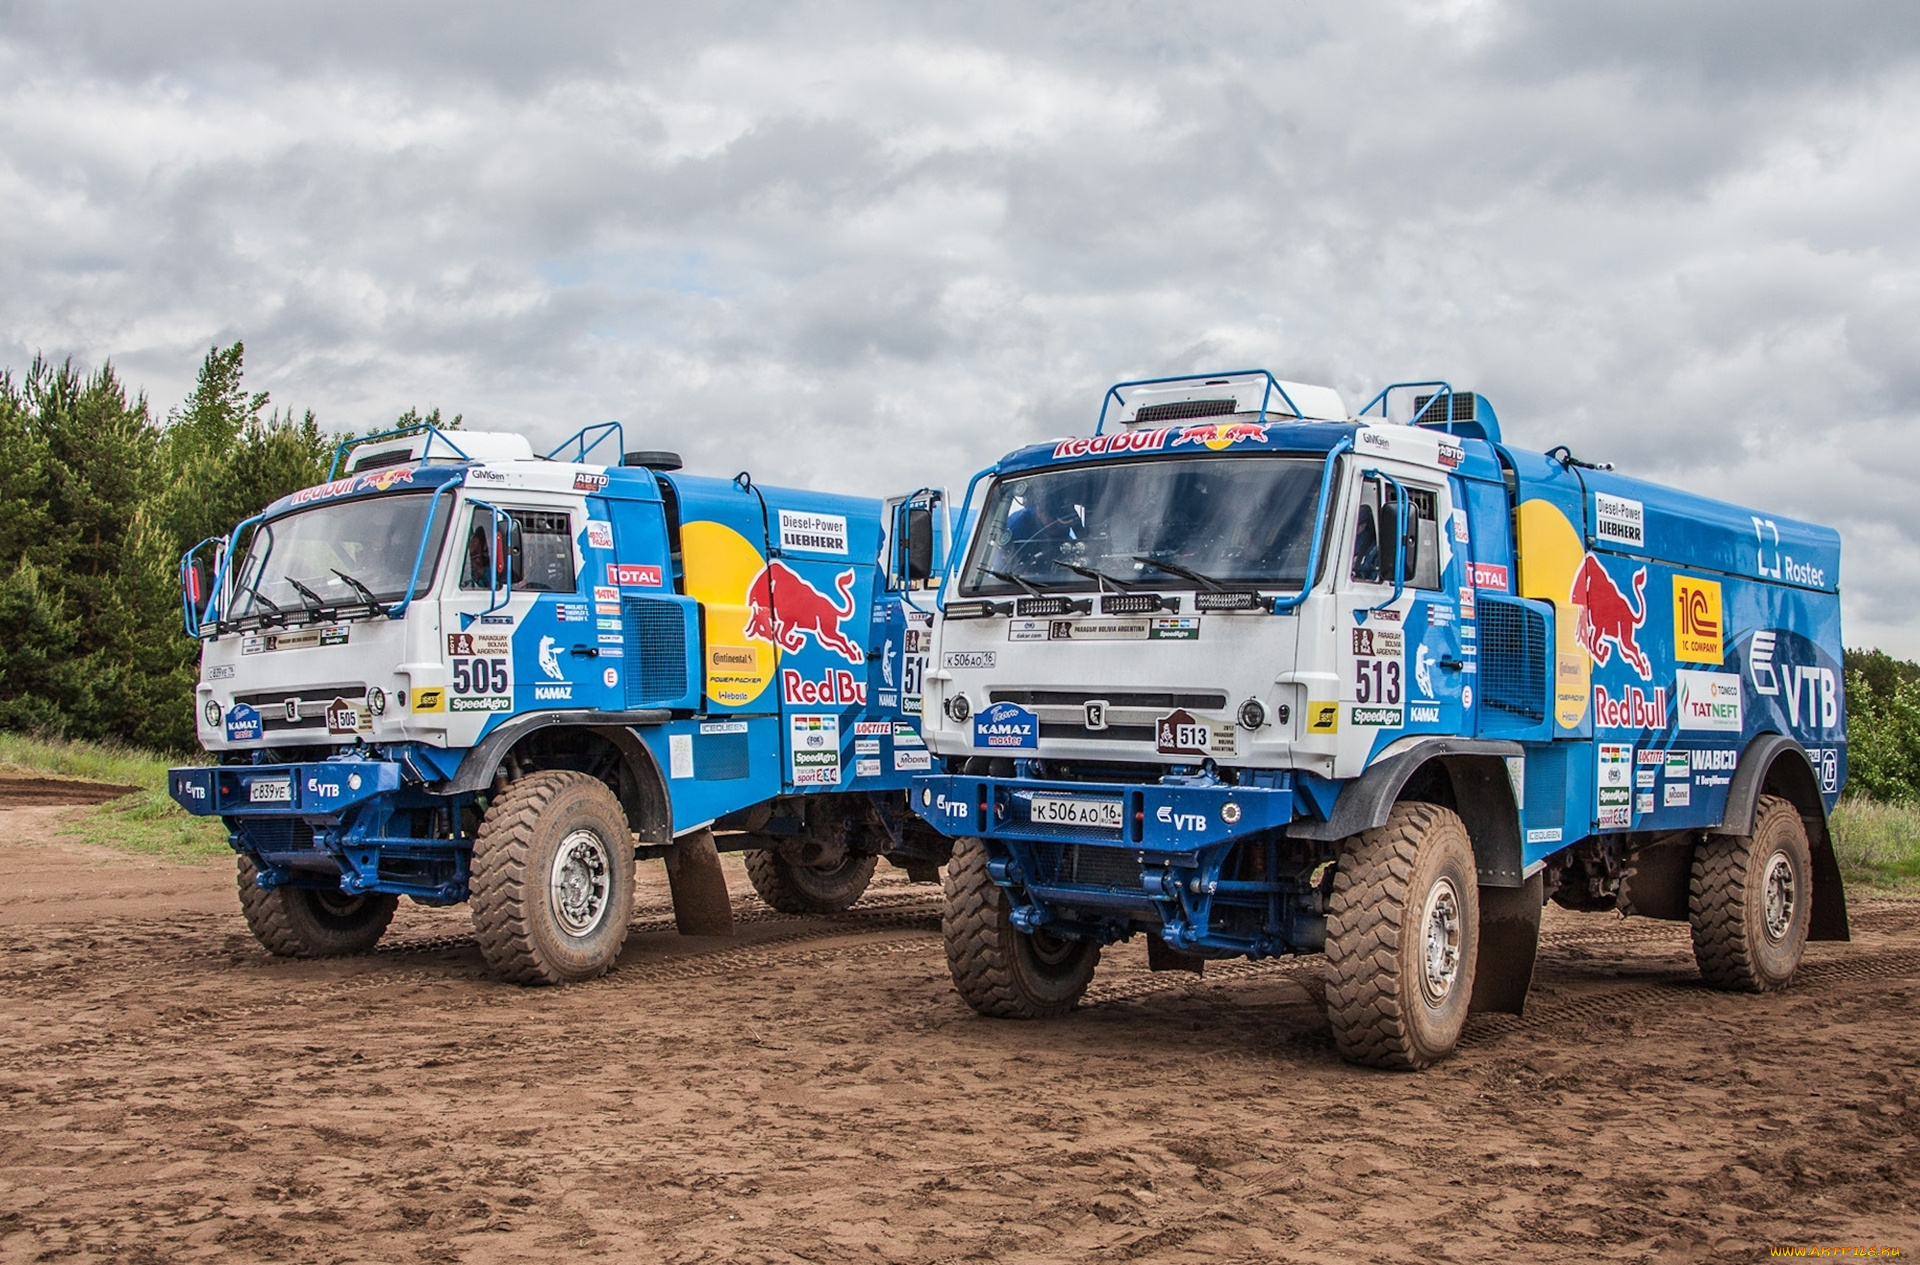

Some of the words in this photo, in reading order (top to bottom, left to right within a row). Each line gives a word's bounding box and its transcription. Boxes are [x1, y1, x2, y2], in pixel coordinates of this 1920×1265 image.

[1053, 436, 1109, 458] Red
[1109, 427, 1171, 453] Bull
[472, 470, 505, 480] GMGen
[576, 474, 608, 485] АВТО
[1598, 498, 1641, 520] Diesel-Power
[783, 514, 844, 533] Diesel-Power
[1599, 520, 1641, 541] LIEBHERR
[784, 533, 844, 550] LIEBHERR
[609, 568, 659, 583] TOTAL
[1467, 567, 1506, 586] TOTAL
[1785, 556, 1825, 587] Rostec
[1117, 624, 1145, 632] ARGENTINA
[1691, 641, 1718, 654] COMPANY
[713, 652, 748, 665] Continental
[453, 658, 508, 694] 505
[607, 671, 614, 683] E
[1356, 659, 1400, 705] 513
[535, 687, 572, 699] KAMAZ
[784, 669, 833, 704] Red
[837, 672, 867, 704] Bu
[452, 697, 508, 710] SpeedAgro
[1782, 664, 1838, 728] VTB
[990, 705, 1019, 723] Team
[1411, 707, 1439, 722] KAMAZ
[1596, 686, 1630, 727] Red
[1633, 688, 1666, 729] Bull
[1692, 702, 1738, 719] TATNEFT
[340, 711, 356, 726] 505
[1354, 709, 1400, 725] SpeedAgro
[228, 720, 258, 731] KAMAZ
[702, 724, 746, 732] ICEQUEEN
[856, 723, 890, 733] LOCTITE
[978, 724, 1031, 735] KAMAZ
[989, 735, 1022, 745] master
[1180, 727, 1207, 746] 513
[796, 752, 836, 764] SpeedAgro
[1638, 751, 1663, 763] LOCTITE
[1691, 750, 1737, 770] WABCO
[797, 774, 815, 783] sport
[191, 786, 205, 799] VTB
[317, 784, 340, 797] VTB
[944, 801, 968, 818] VTB
[1174, 814, 1206, 831] VTB
